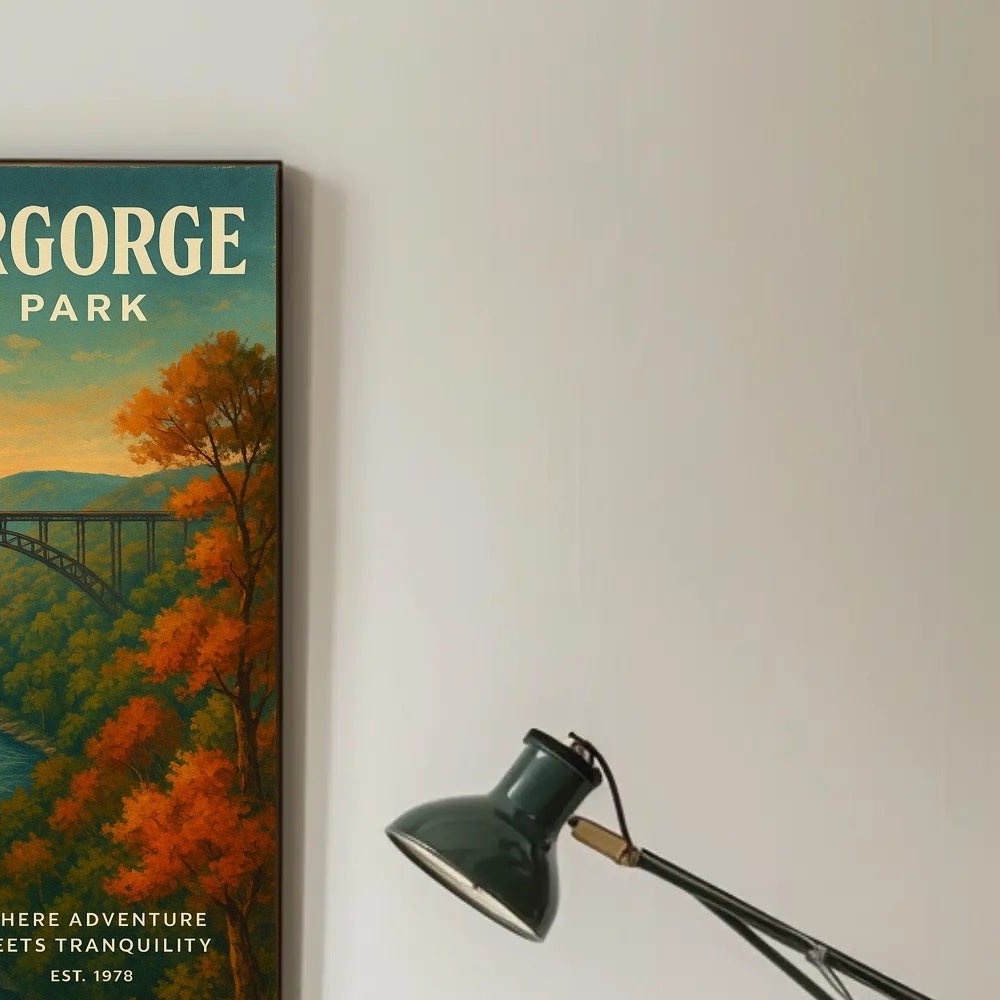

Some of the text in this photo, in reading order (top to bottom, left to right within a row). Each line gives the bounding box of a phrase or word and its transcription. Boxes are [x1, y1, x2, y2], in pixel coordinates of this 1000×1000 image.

[20, 294, 149, 322] PARK
[69, 912, 207, 926] ADVENTURE
[55, 938, 212, 954] TRANQUILITY
[50, 970, 134, 982] EST. 1978
